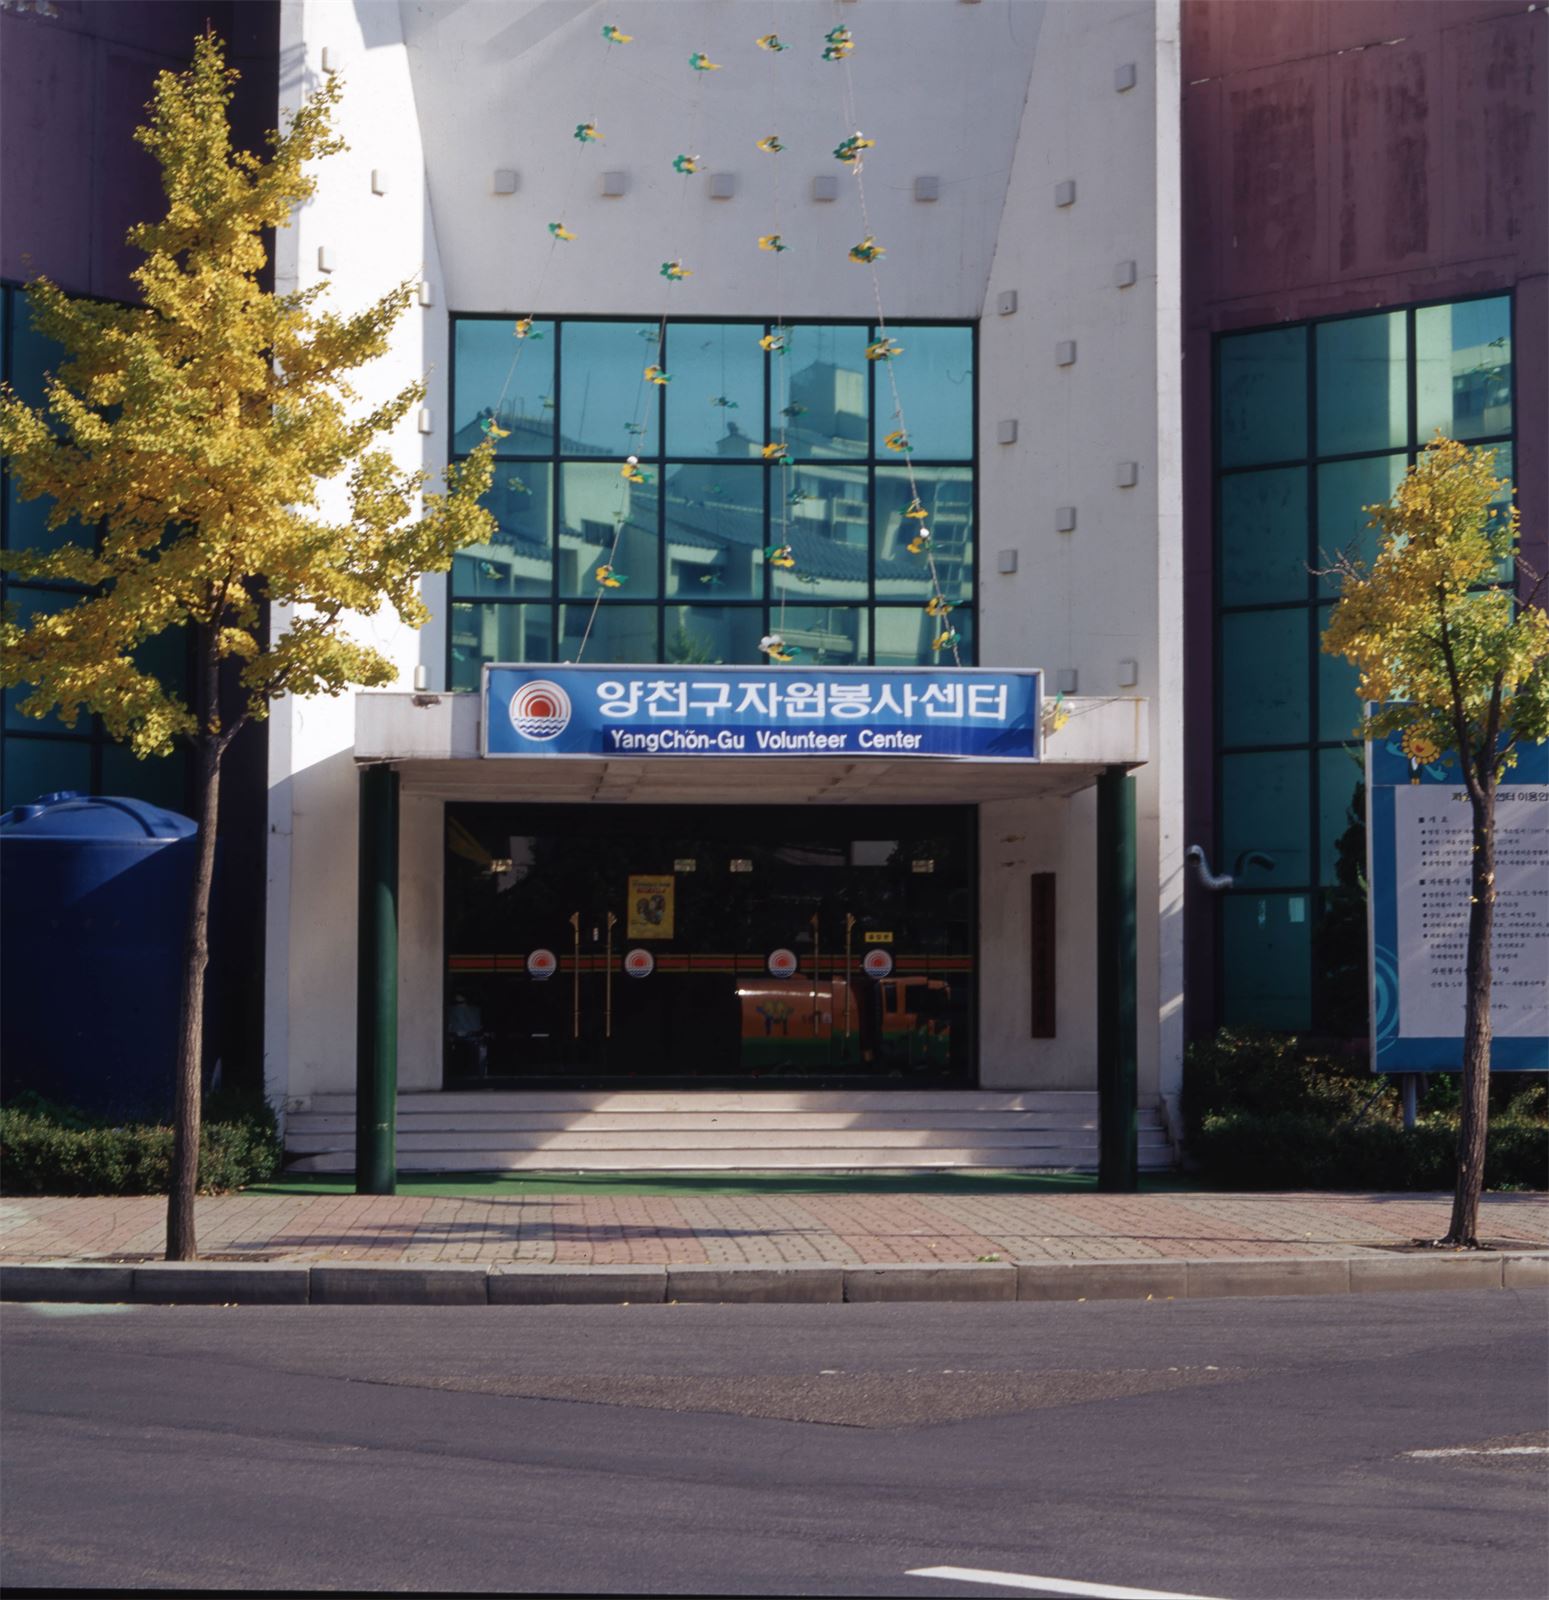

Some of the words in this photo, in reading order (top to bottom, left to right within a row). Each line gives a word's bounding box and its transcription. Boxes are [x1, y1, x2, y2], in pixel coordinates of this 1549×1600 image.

[596, 680, 1008, 720] 양천구자원봉사센터
[756, 730, 847, 749] Volunteer
[858, 729, 922, 749] Center
